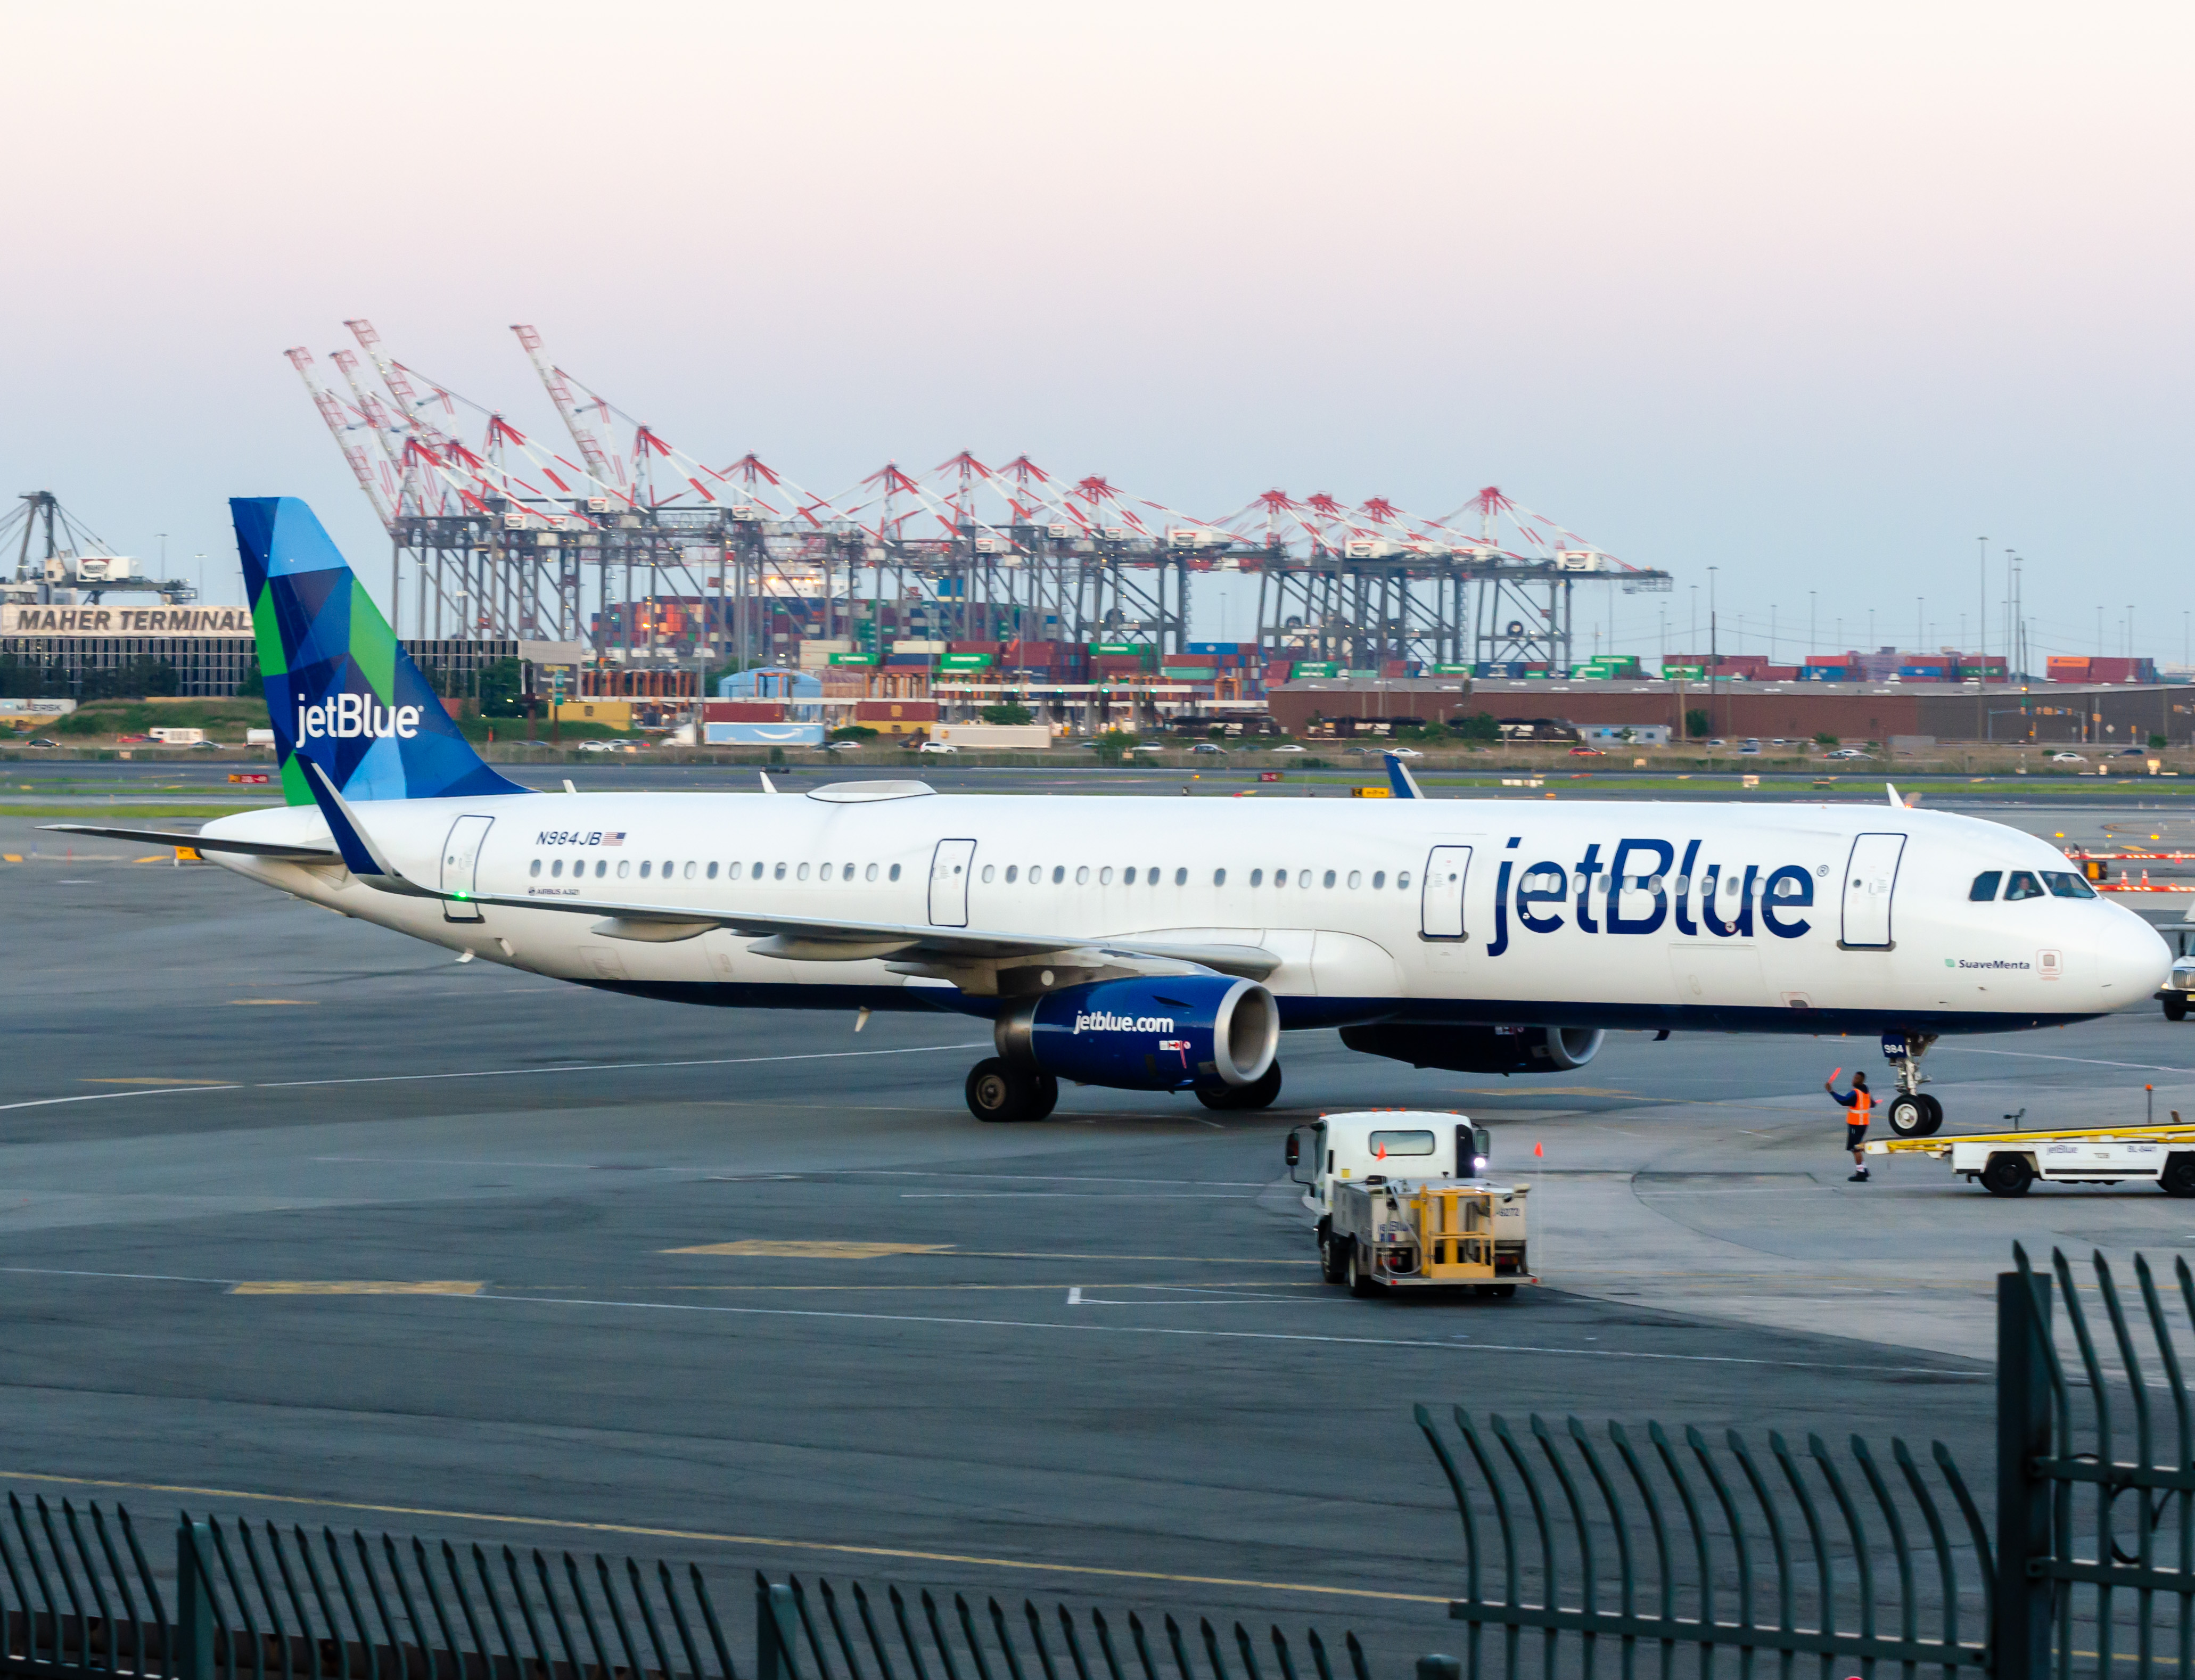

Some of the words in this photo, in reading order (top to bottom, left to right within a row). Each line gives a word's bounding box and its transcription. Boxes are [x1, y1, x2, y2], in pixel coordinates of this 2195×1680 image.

[18, 610, 110, 630] MAHER
[536, 831, 603, 845] N984JB
[1958, 960, 2030, 969] SuaveMenta
[1073, 1010, 1174, 1035] jetblue.com
[1884, 1044, 1905, 1053] 984
[2046, 1144, 2078, 1156] jetBlue
